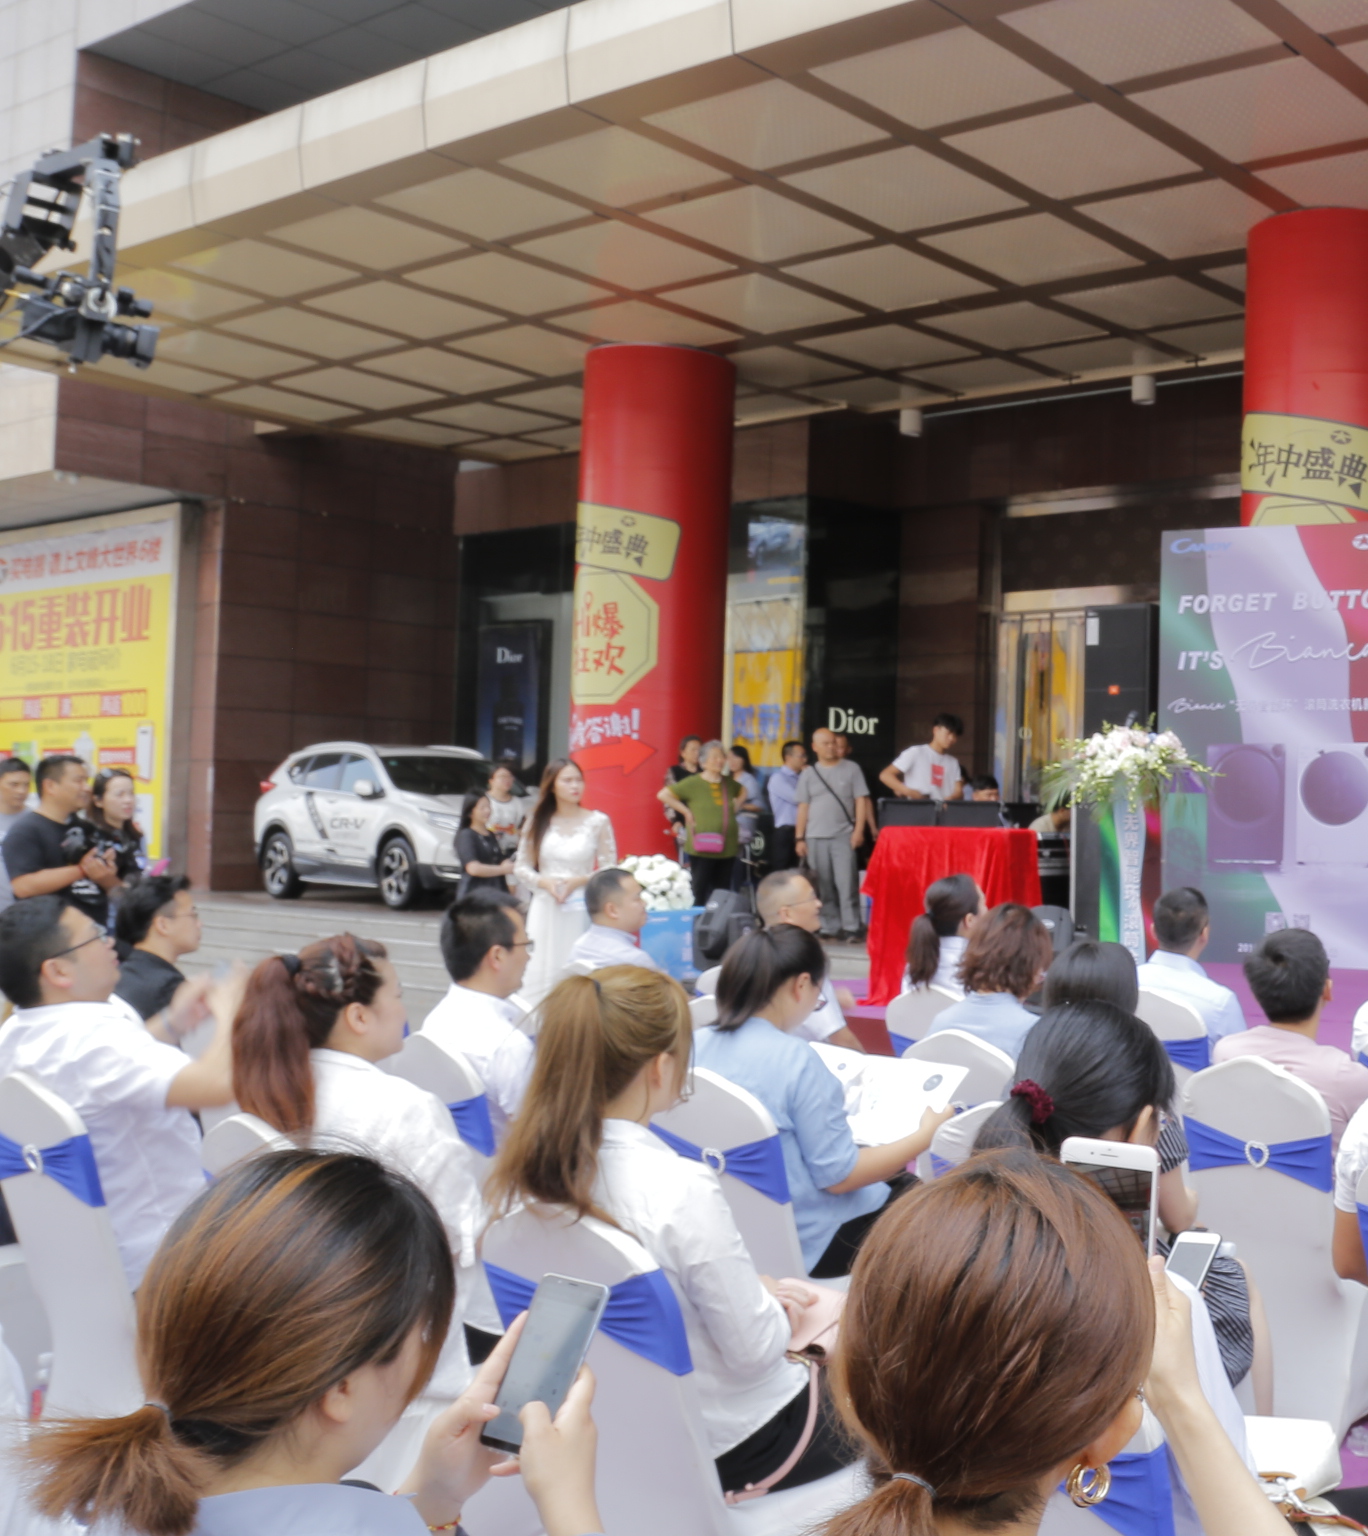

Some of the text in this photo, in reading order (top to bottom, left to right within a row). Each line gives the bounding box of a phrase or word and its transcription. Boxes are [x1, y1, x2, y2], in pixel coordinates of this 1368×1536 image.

[1250, 442, 1368, 483] 年中盛典
[1177, 592, 1277, 614] FORGET
[1177, 651, 1224, 671] IT'S
[828, 706, 879, 735] Dior
[329, 817, 366, 830] CR-V
